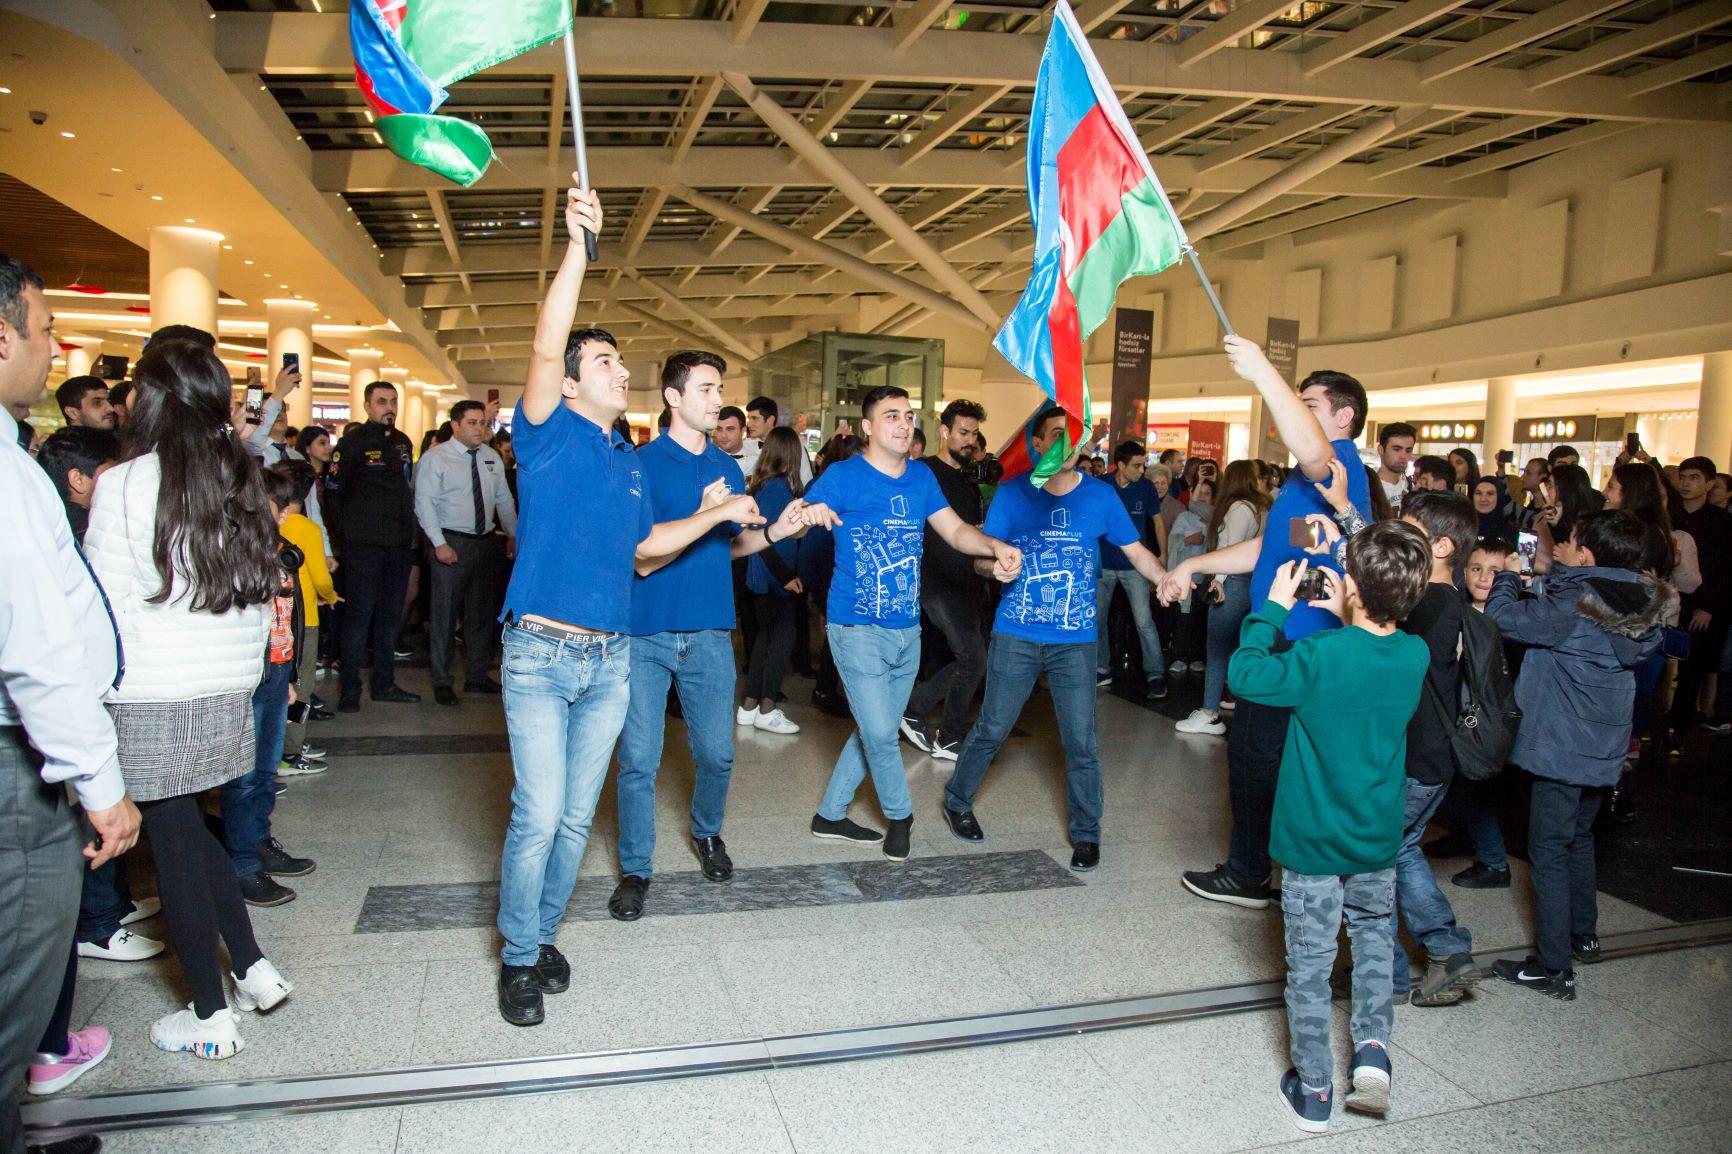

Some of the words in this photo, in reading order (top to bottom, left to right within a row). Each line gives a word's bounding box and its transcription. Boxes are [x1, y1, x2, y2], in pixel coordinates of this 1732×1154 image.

[1039, 530, 1083, 538] CINEMAPLUS
[526, 621, 544, 632] VIP
[565, 632, 590, 643] PIER
